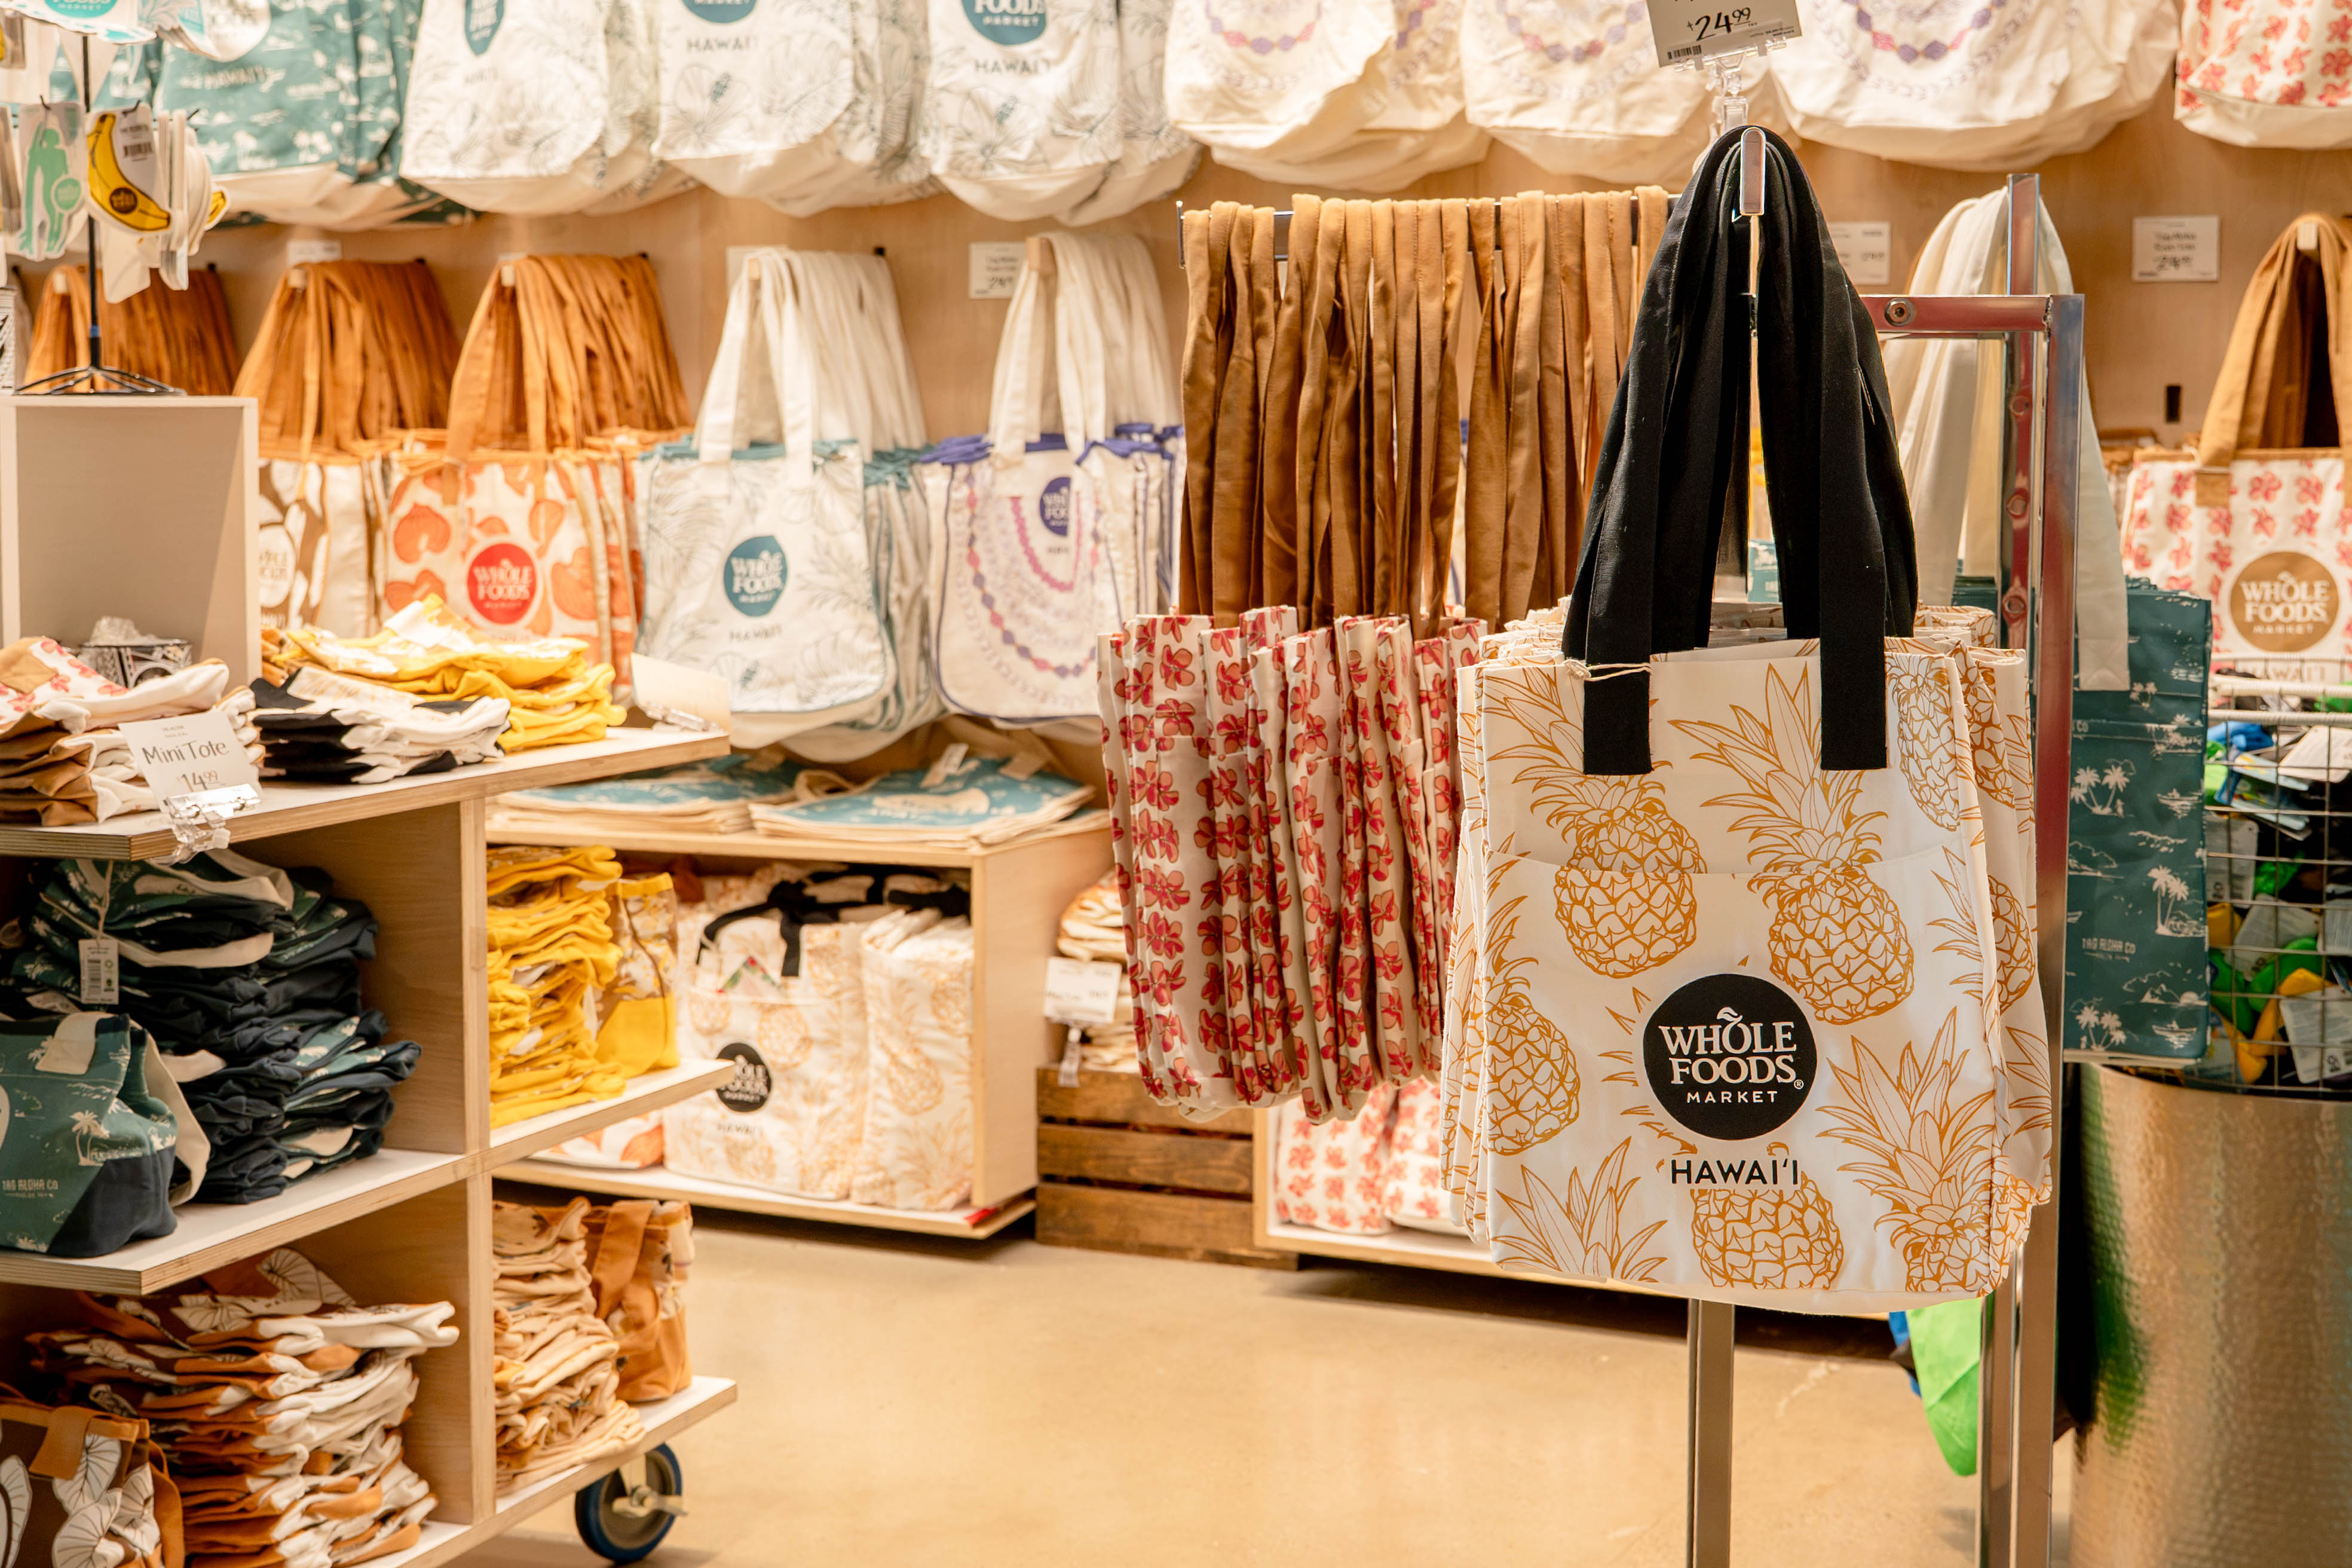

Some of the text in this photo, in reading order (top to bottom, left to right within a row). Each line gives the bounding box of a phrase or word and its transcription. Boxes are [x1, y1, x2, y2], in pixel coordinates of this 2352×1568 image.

[982, 16, 1039, 27] MARKET
[473, 562, 533, 584] WHOLE
[731, 551, 784, 577] WHOLE
[477, 584, 531, 601] FOODS
[2241, 575, 2330, 602] WHOLE
[2253, 624, 2314, 635] MARKET
[142, 740, 230, 765] Mini Tote
[1658, 1010, 1797, 1056] WHOLE
[1687, 1091, 1778, 1104] MARKET
